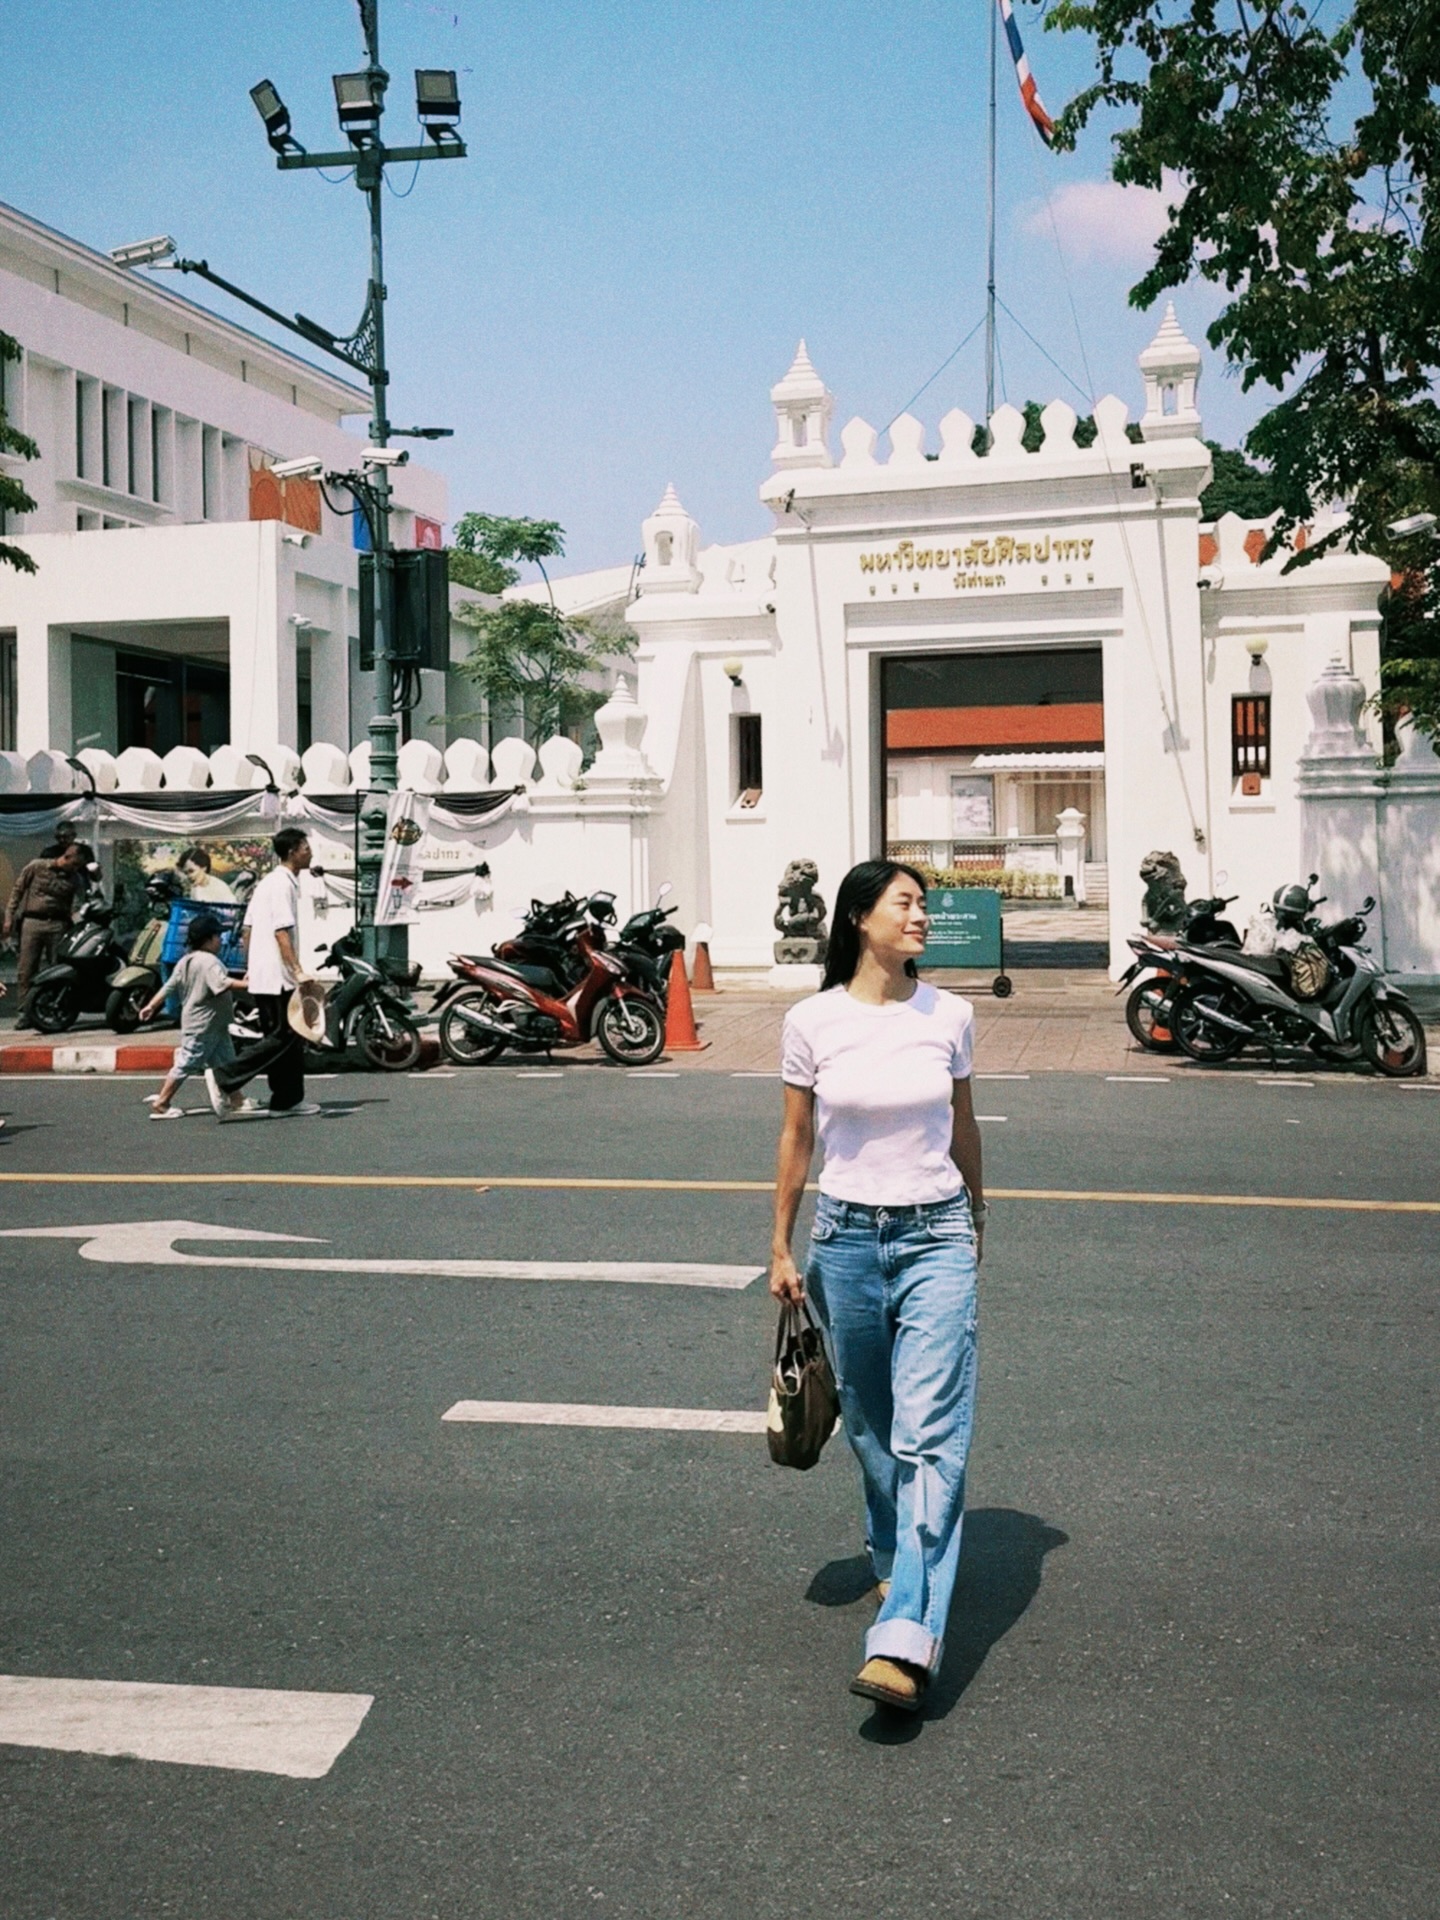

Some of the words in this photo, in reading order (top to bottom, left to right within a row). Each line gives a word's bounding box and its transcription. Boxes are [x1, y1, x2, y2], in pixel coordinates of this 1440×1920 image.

[859, 535, 1094, 574] มหาวิทยาลัยศิลปากร
